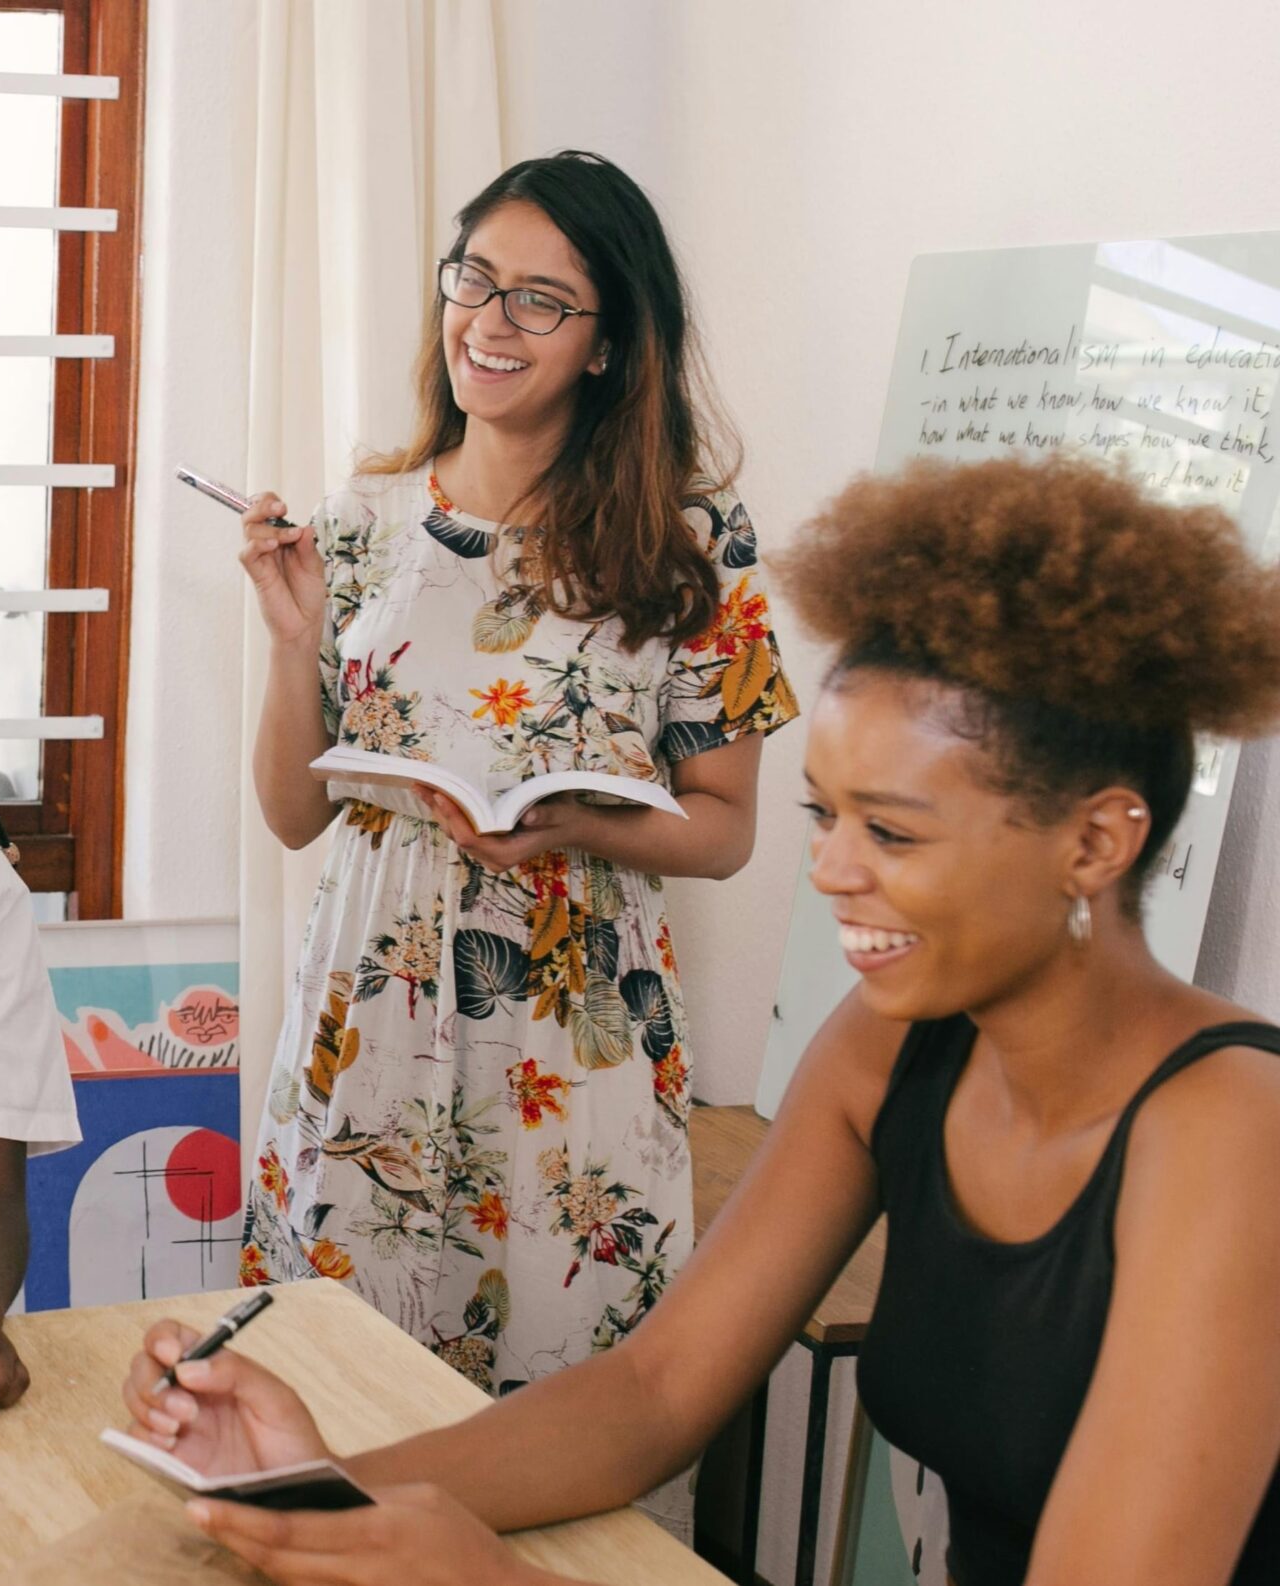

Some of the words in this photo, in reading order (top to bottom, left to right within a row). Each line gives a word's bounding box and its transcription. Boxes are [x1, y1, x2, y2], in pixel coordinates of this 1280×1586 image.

[938, 324, 1119, 374] Internationalism
[1141, 336, 1166, 369] in
[958, 385, 997, 413] what
[1007, 394, 1028, 409] we
[1091, 384, 1124, 411] how
[1137, 394, 1162, 411] we
[1175, 385, 1233, 415] know
[1243, 386, 1271, 420] it,
[919, 417, 948, 445] how
[956, 420, 990, 443] what
[998, 431, 1016, 445] we
[1023, 421, 1066, 448] know
[1078, 423, 1131, 455] shapes
[1140, 425, 1177, 448] how
[1188, 433, 1210, 449] we
[1220, 423, 1274, 464] think,
[1182, 460, 1219, 488] how
[1226, 469, 1244, 493] it
